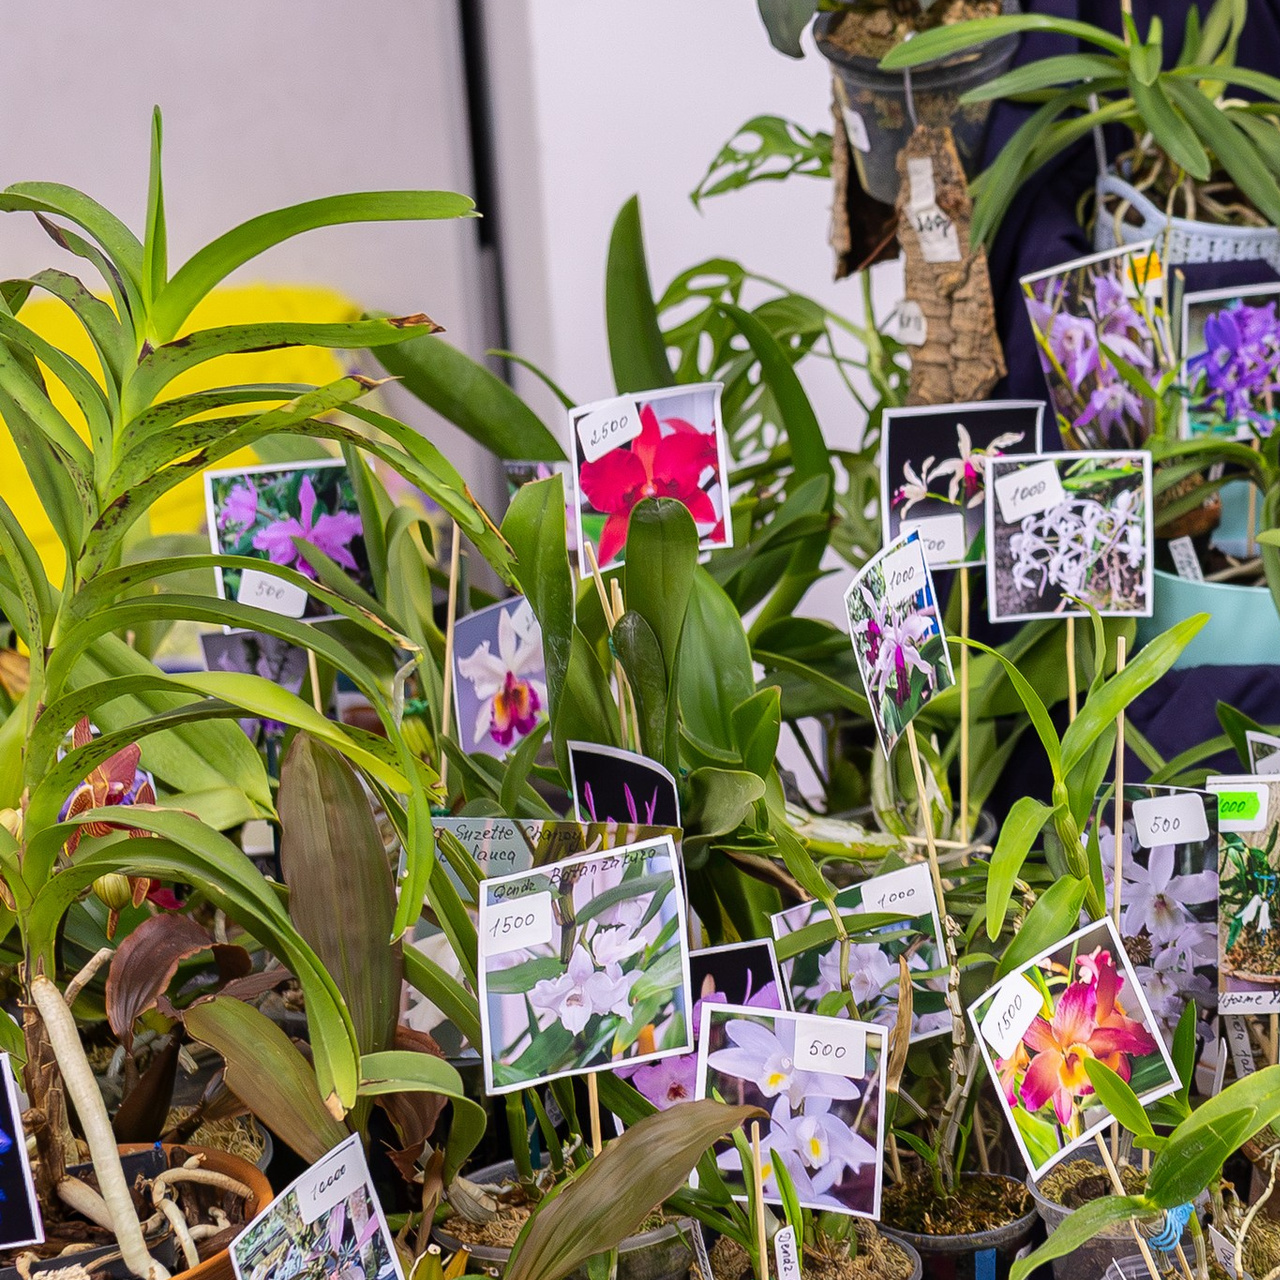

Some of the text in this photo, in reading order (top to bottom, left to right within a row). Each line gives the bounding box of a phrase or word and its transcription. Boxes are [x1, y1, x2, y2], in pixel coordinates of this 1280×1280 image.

[591, 415, 628, 447] 2500
[1011, 480, 1047, 507] 1000
[256, 581, 285, 601] 500
[890, 565, 915, 592] 1000
[1150, 816, 1181, 834] 500
[877, 888, 916, 909] 1000
[489, 913, 535, 938] 1500
[997, 994, 1023, 1040] 1500
[809, 1039, 847, 1059] 500
[310, 1164, 347, 1201] 10000
